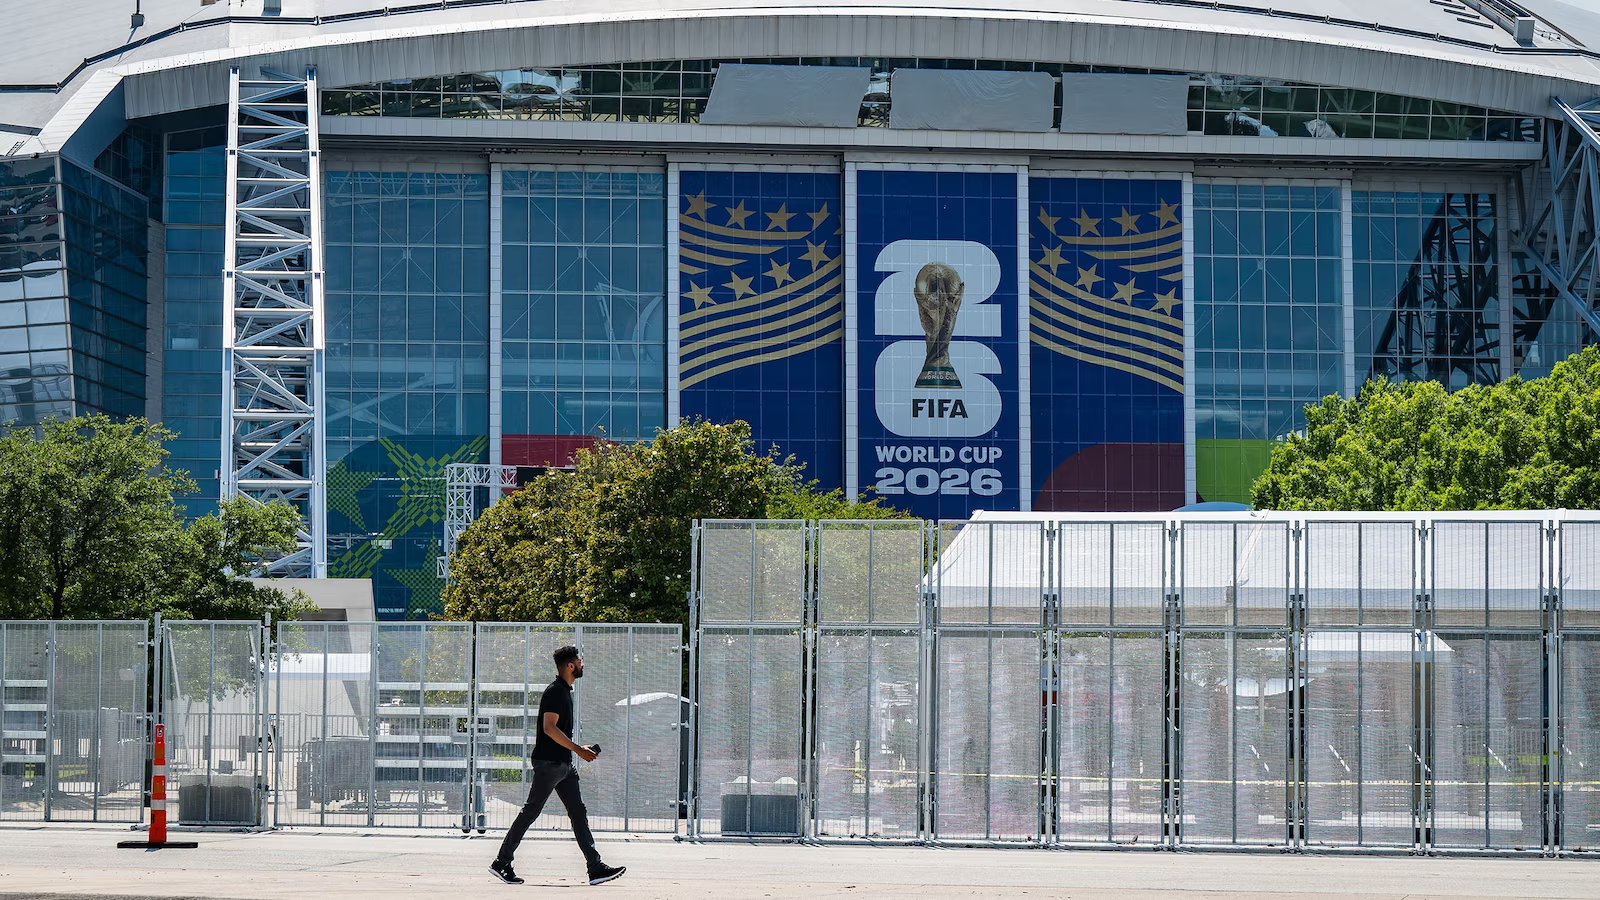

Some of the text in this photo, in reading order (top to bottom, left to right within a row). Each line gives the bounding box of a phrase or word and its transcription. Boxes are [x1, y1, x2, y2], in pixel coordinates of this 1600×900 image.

[912, 398, 968, 418] FIFA
[875, 445, 1003, 463] WORLD CUP
[875, 467, 1003, 496] 2026
